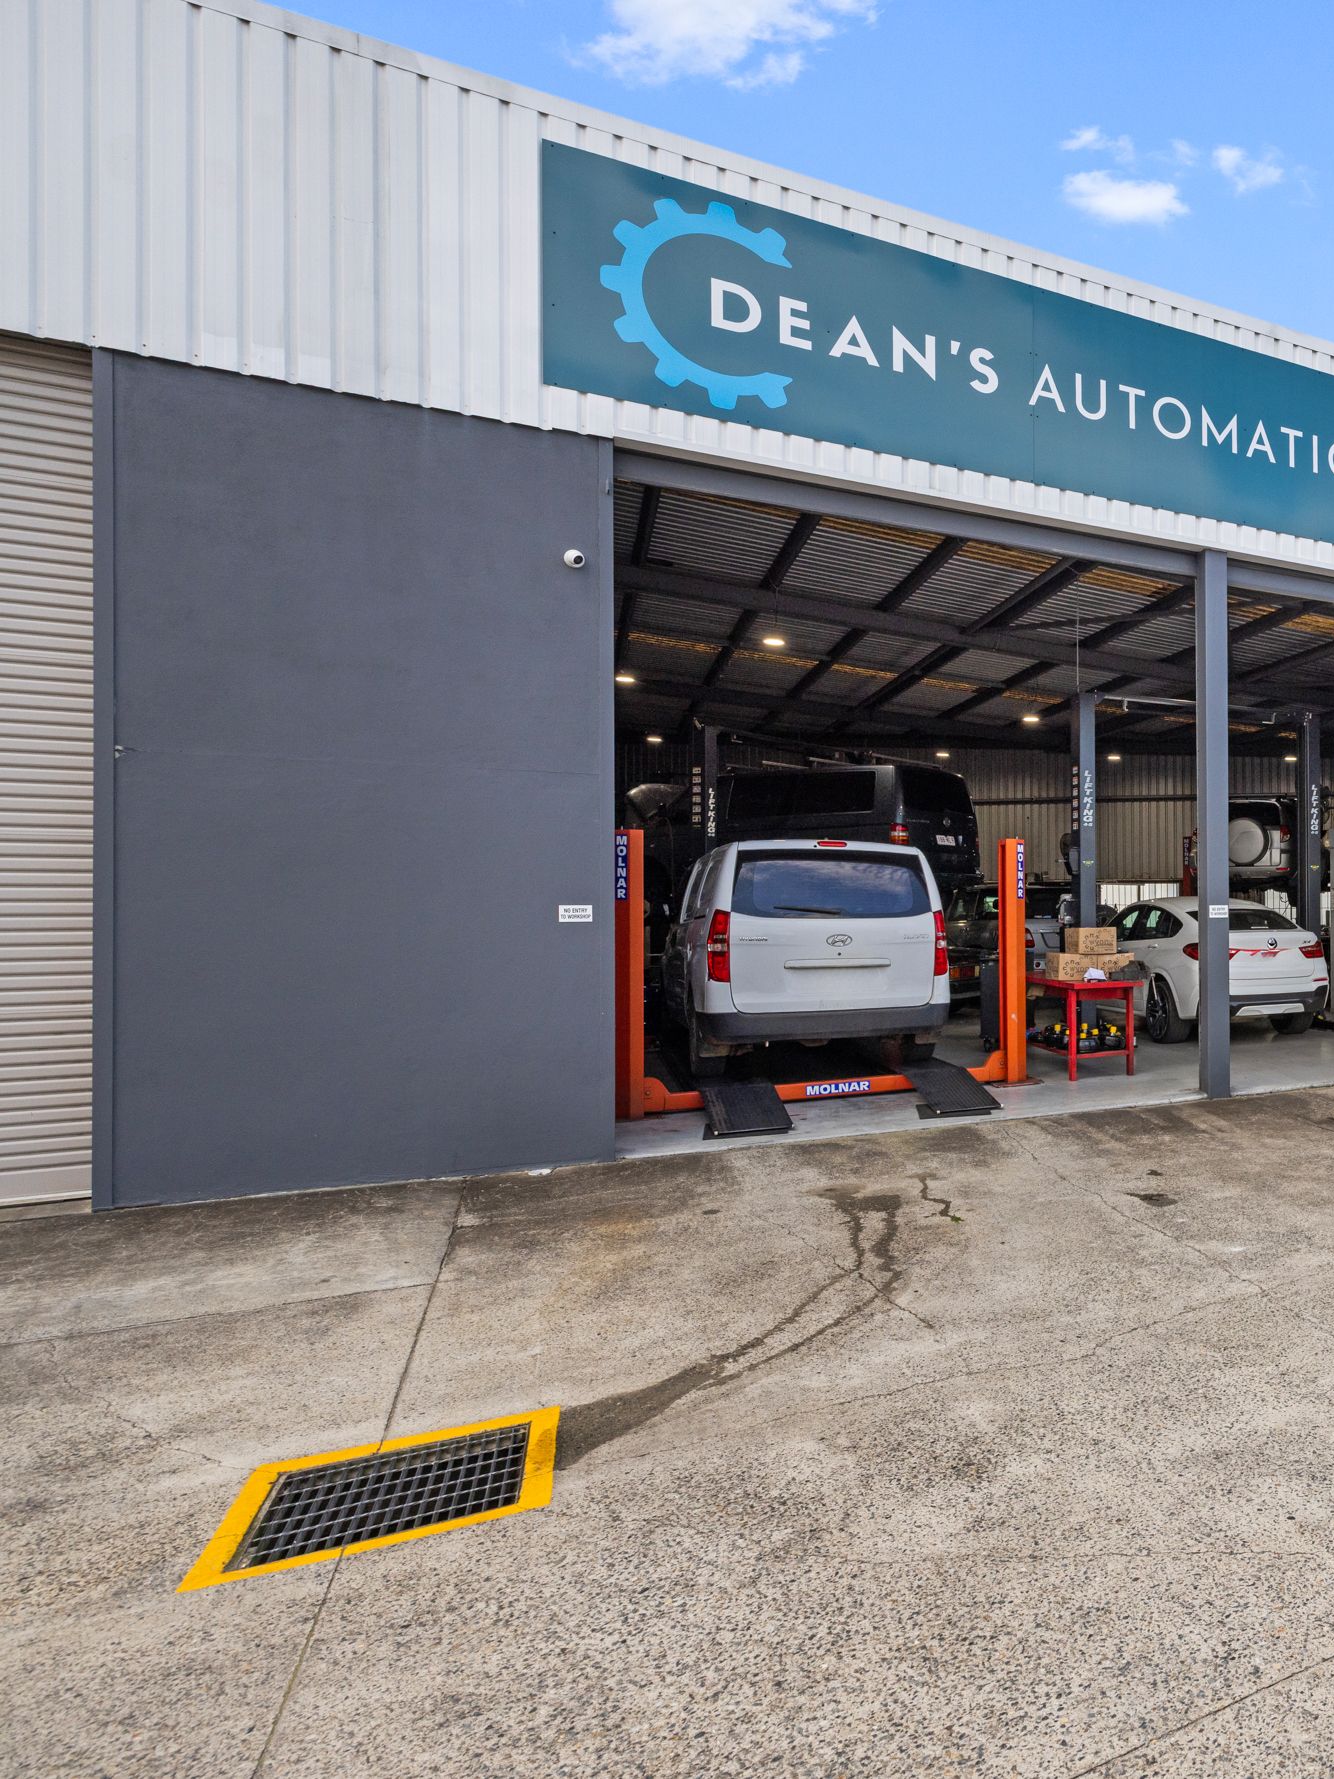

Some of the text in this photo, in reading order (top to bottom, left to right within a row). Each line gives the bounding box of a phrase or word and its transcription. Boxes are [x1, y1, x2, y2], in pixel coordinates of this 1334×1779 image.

[710, 277, 999, 394] DEAN'S
[616, 835, 627, 899] MOLNAR
[806, 1081, 870, 1096] MOLNAR
